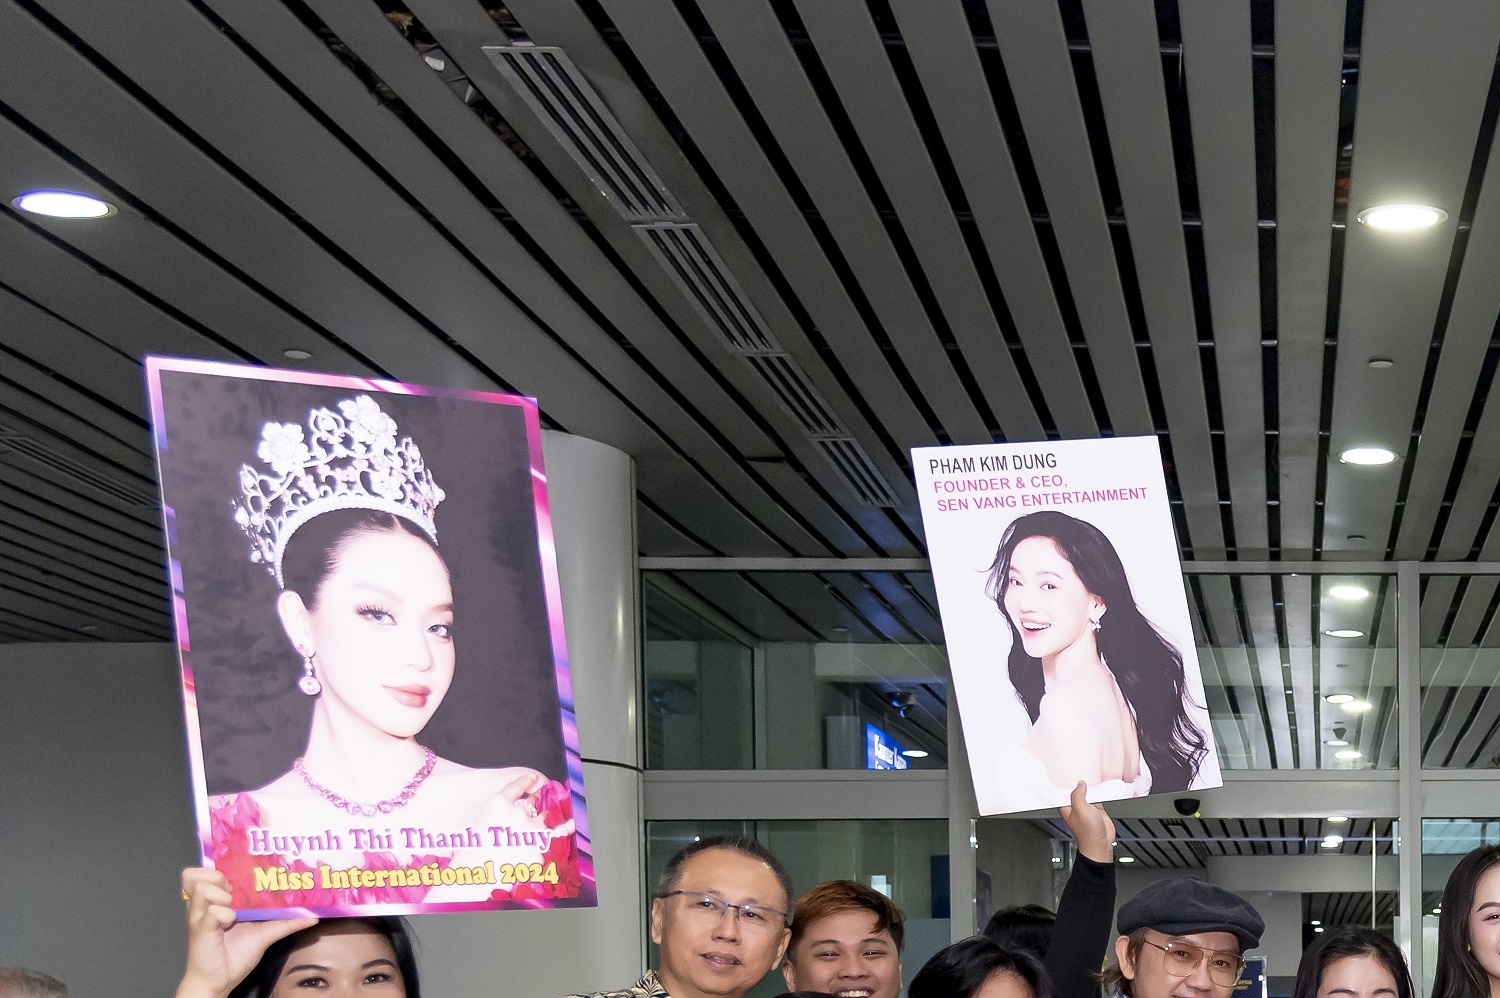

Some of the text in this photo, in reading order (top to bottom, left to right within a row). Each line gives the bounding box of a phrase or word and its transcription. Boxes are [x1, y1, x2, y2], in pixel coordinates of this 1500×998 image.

[929, 453, 1057, 475] PHAM KIM DUNG
[933, 474, 1068, 493] FOUNDER & CEO,
[937, 487, 1148, 512] SEN VANG ENTERTAINMENT
[249, 825, 552, 857] Huynh Thi Thanh Thuy
[252, 861, 560, 892] Miss International 2024
